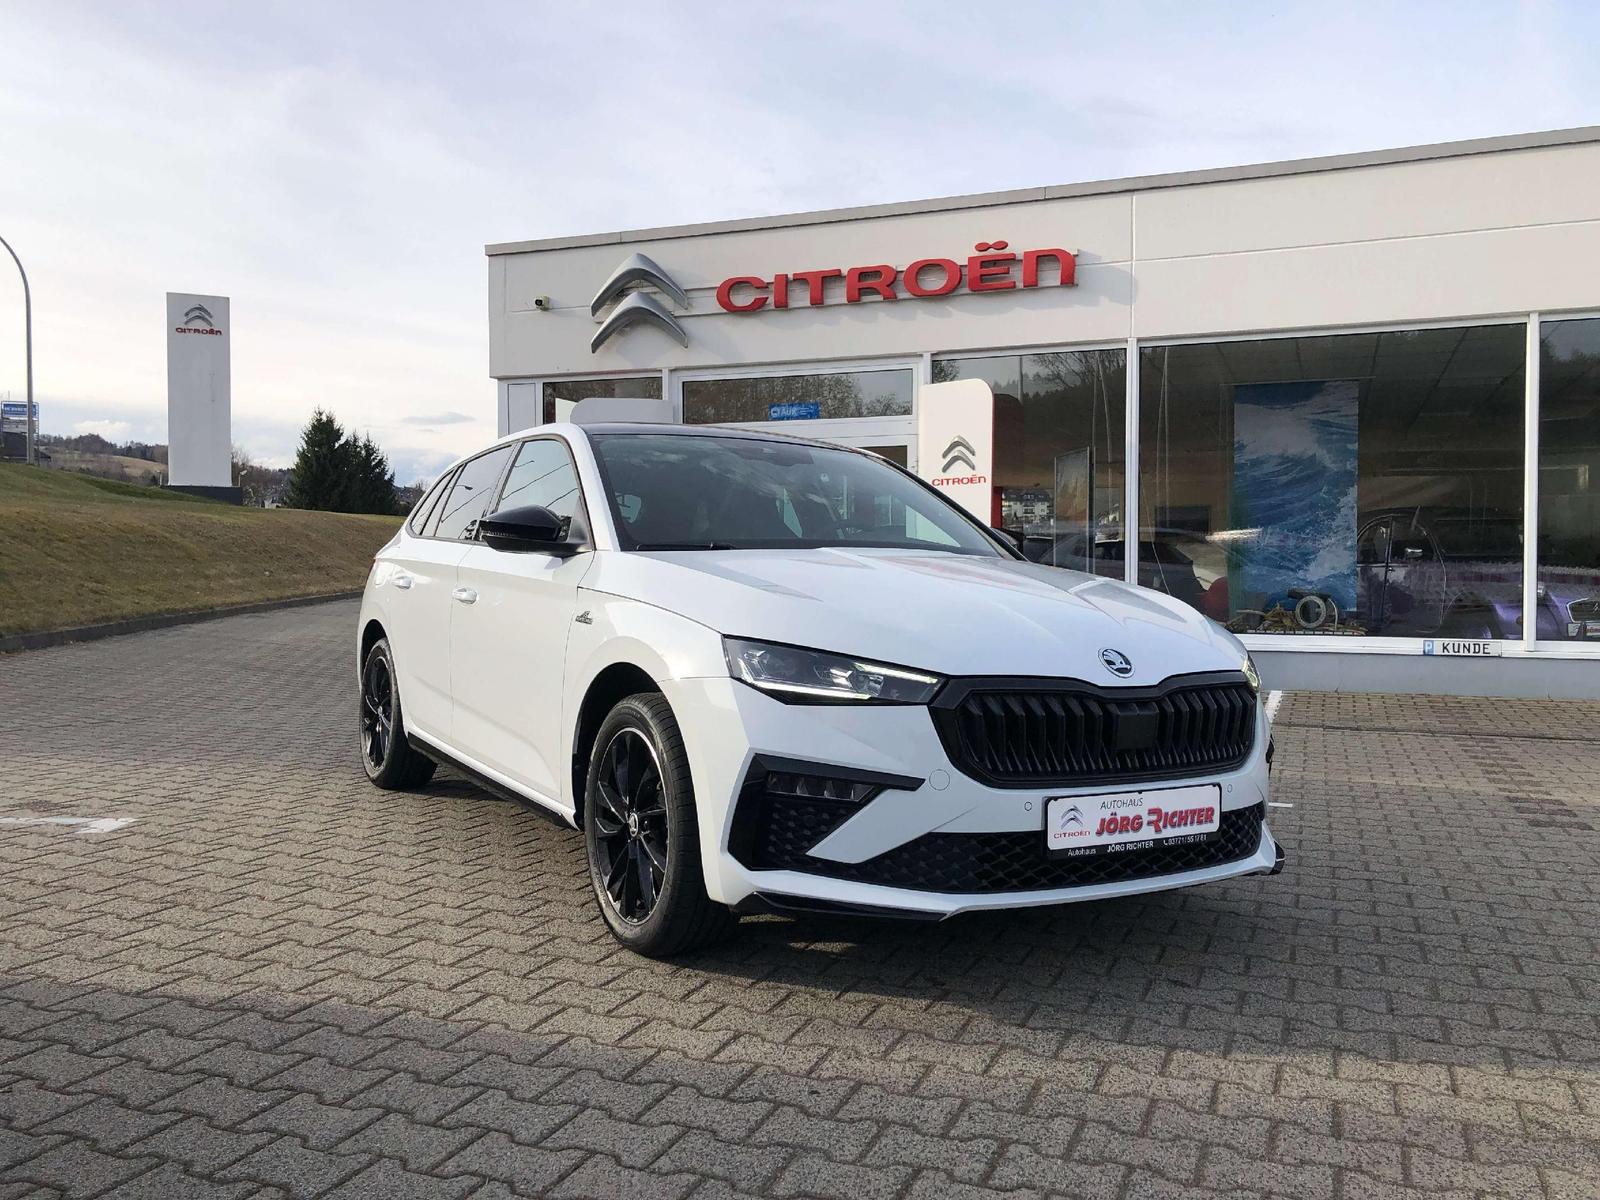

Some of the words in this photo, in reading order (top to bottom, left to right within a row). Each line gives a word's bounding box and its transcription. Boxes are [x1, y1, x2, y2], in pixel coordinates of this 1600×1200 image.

[716, 240, 1077, 313] CITROËN
[1442, 642, 1491, 655] KUNDE
[1100, 797, 1144, 810] AUTOHAUS
[1095, 811, 1144, 837] JÖRG
[1147, 806, 1215, 834] RICHTER
[1067, 848, 1097, 857] Autohaus
[1107, 843, 1125, 853] JÖRG
[1126, 840, 1154, 851] RICHTER
